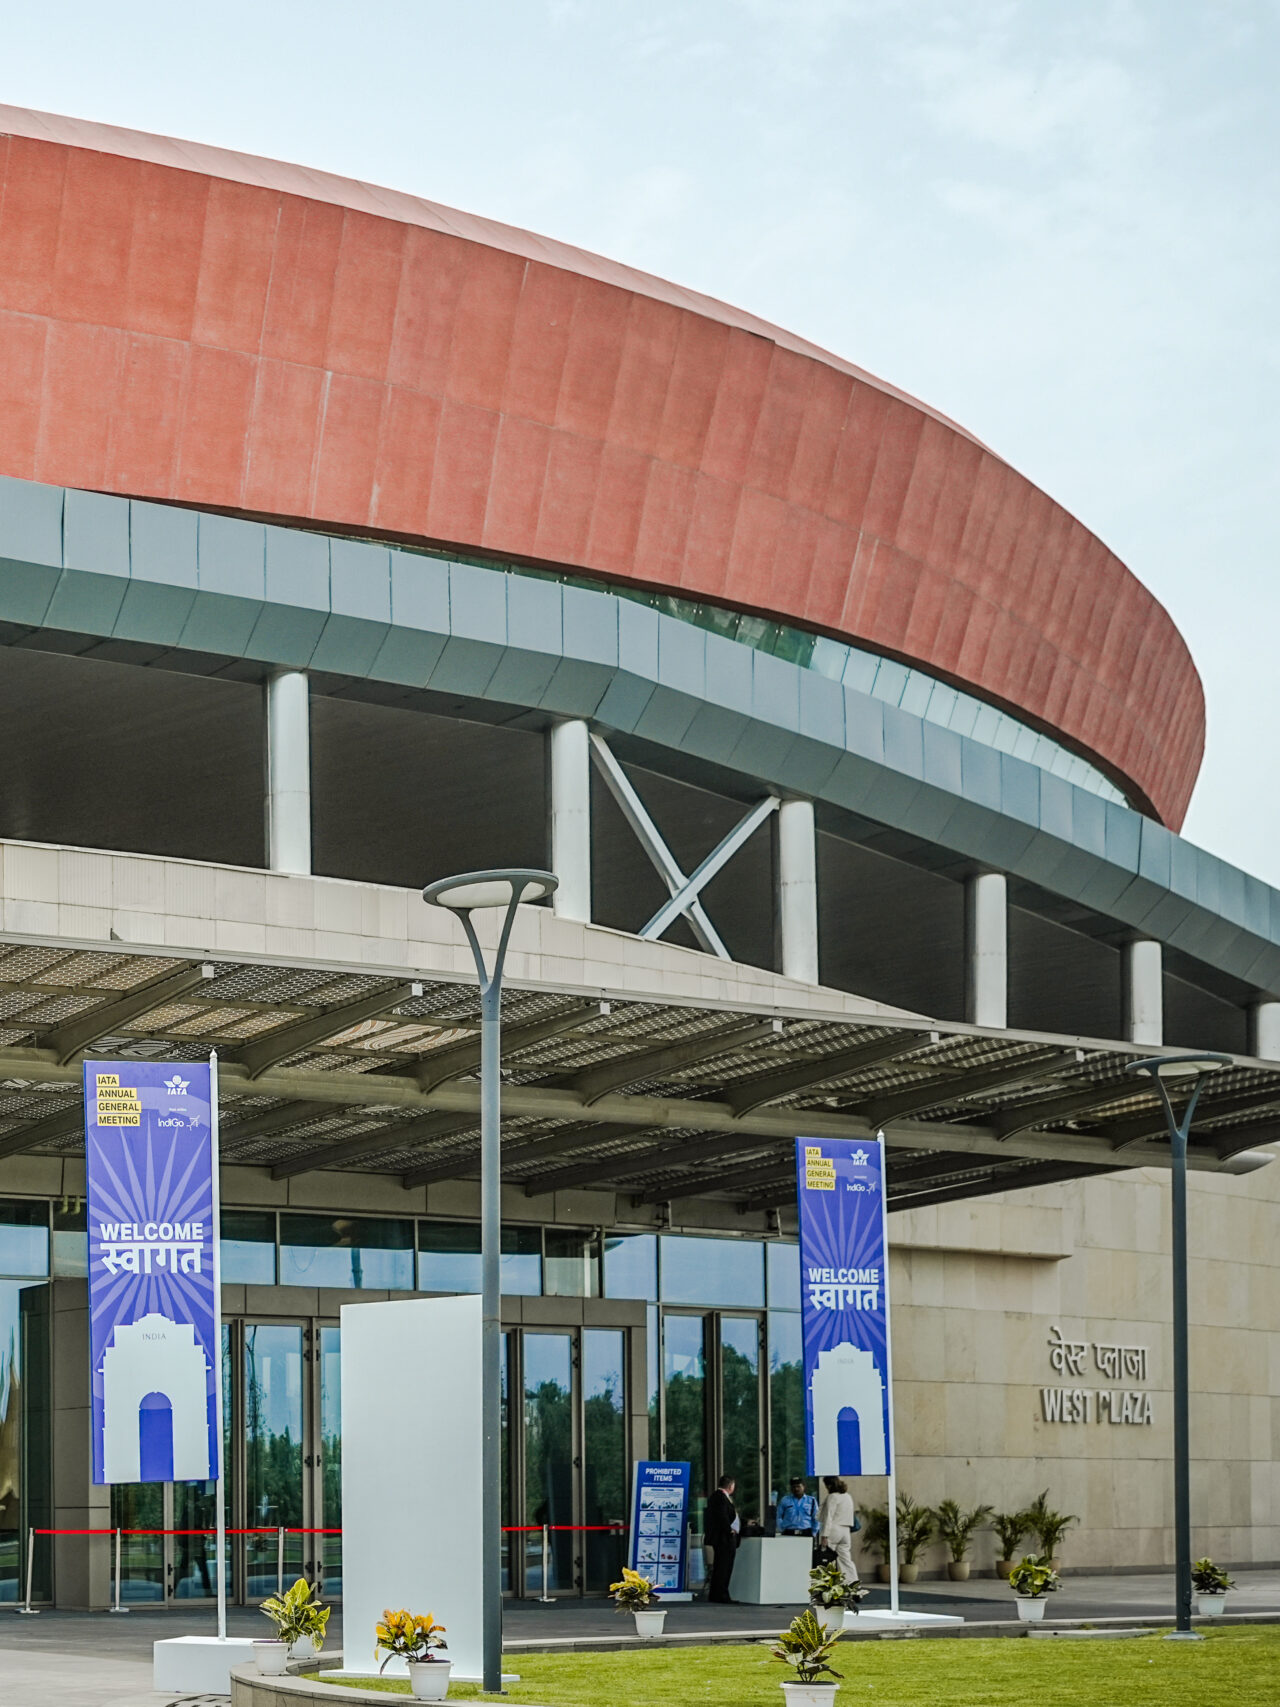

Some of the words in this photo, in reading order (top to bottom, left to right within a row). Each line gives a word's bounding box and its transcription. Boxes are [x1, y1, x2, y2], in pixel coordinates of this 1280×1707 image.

[97, 1076, 117, 1085] IATA
[98, 1090, 135, 1098] ANNUAL
[167, 1088, 188, 1096] IATA
[98, 1103, 140, 1111] GENERAL
[98, 1116, 138, 1125] MEETING
[158, 1117, 185, 1128] IndiGo
[806, 1148, 820, 1156] IATA
[806, 1159, 831, 1167] ANNUAL
[806, 1170, 835, 1178] GENERAL
[807, 1181, 834, 1189] MEETING
[99, 1222, 204, 1242] WELCOME
[100, 1242, 204, 1276] स्वागत
[808, 1268, 880, 1284] WELCOME
[809, 1284, 880, 1312] स्वागत
[141, 1332, 167, 1341] INDIA
[1047, 1326, 1091, 1376] वेस्ट
[1092, 1342, 1150, 1381] प्लाजा
[1040, 1388, 1094, 1424] WEST
[1097, 1390, 1155, 1425] PLAZA
[645, 1467, 682, 1476] PROHIBITED
